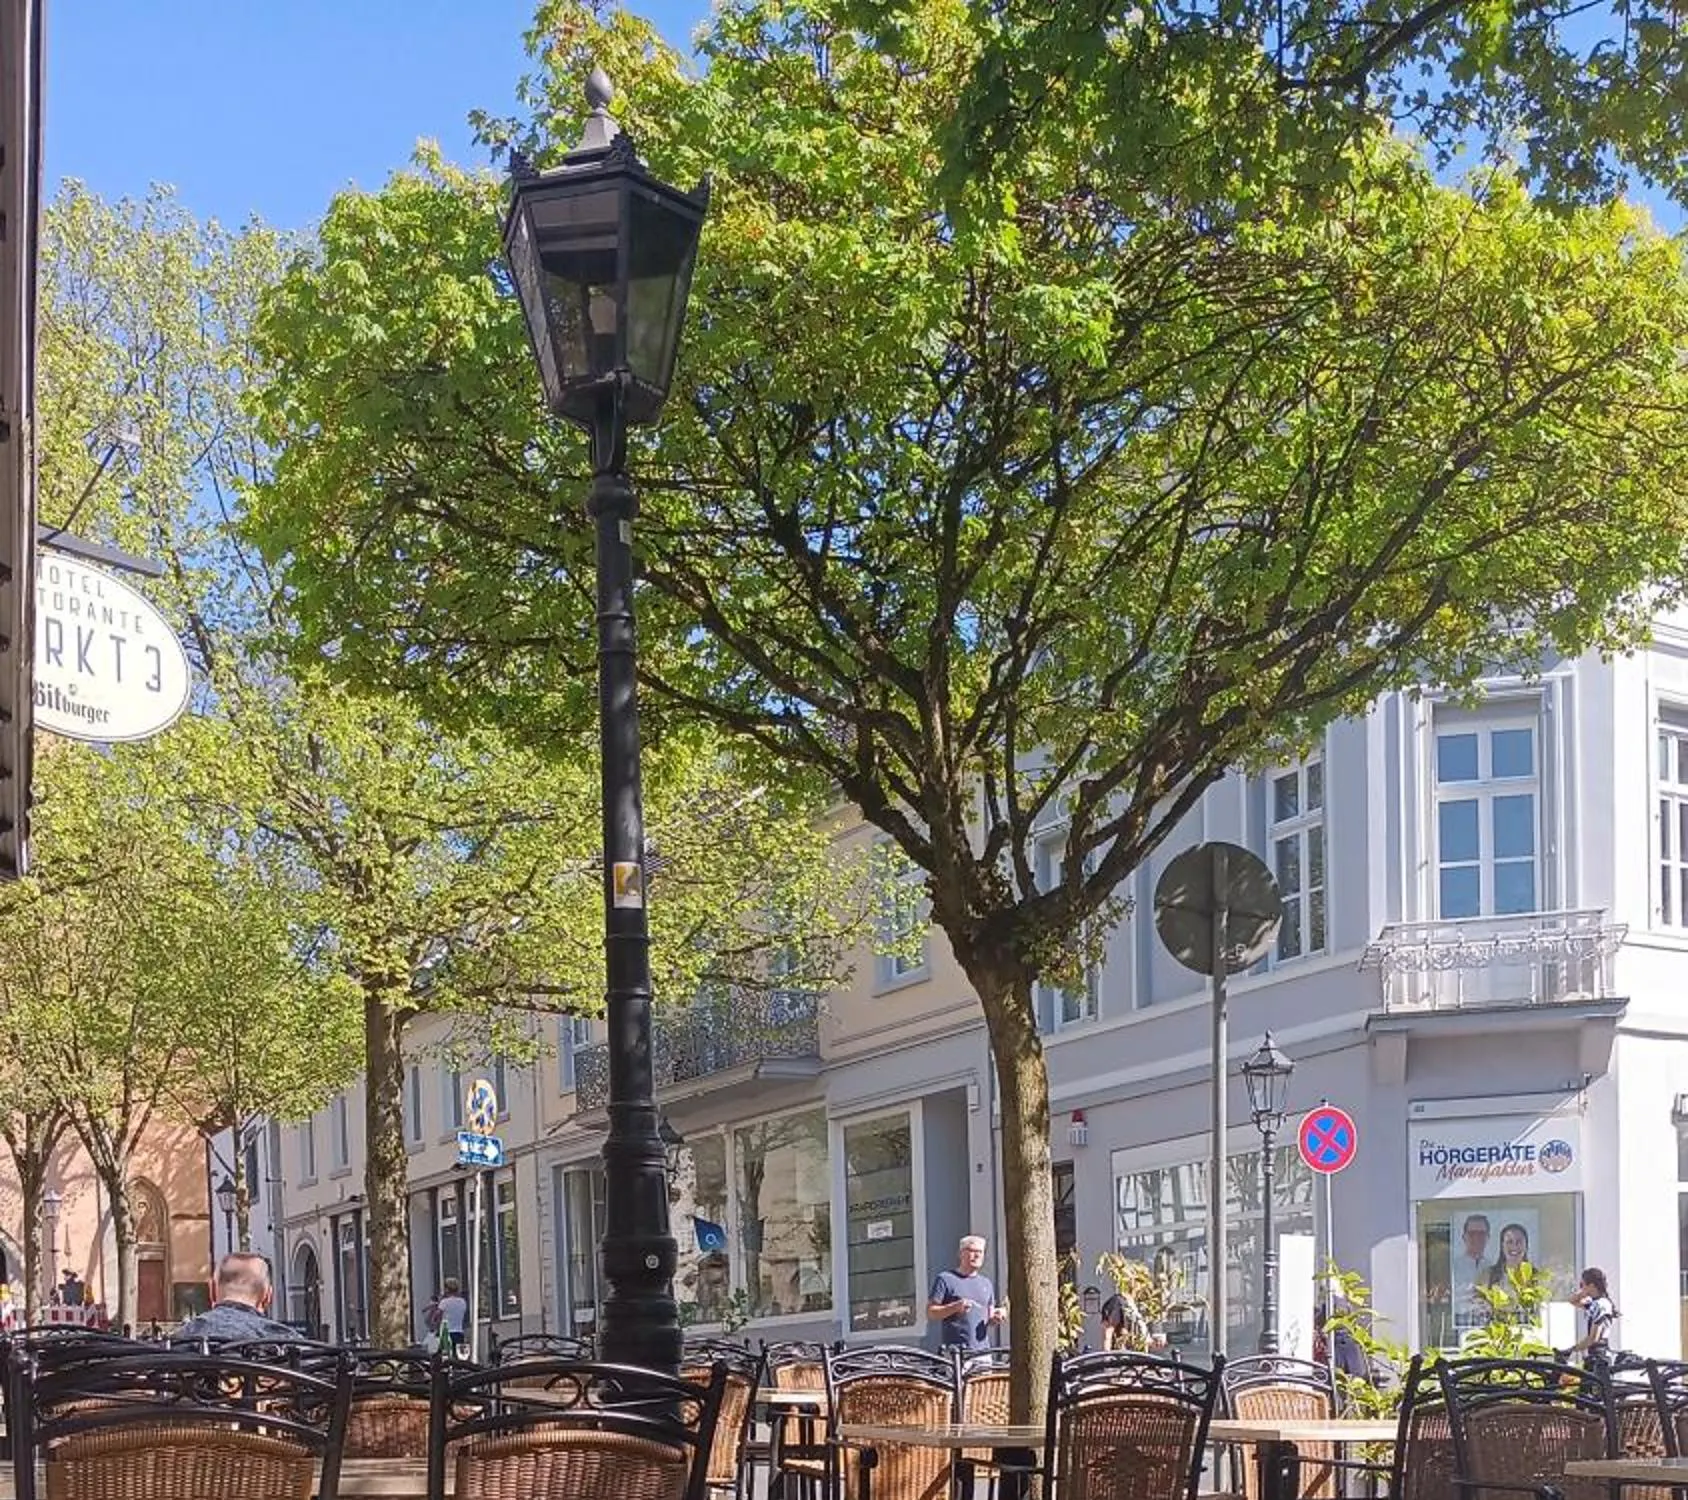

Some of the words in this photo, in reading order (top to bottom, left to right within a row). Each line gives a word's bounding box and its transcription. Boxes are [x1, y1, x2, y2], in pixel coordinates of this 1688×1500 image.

[145, 644, 162, 693] 3
[1420, 1142, 1536, 1166] HÖRGERÄTE
[1435, 1162, 1536, 1183] Manufaktur
